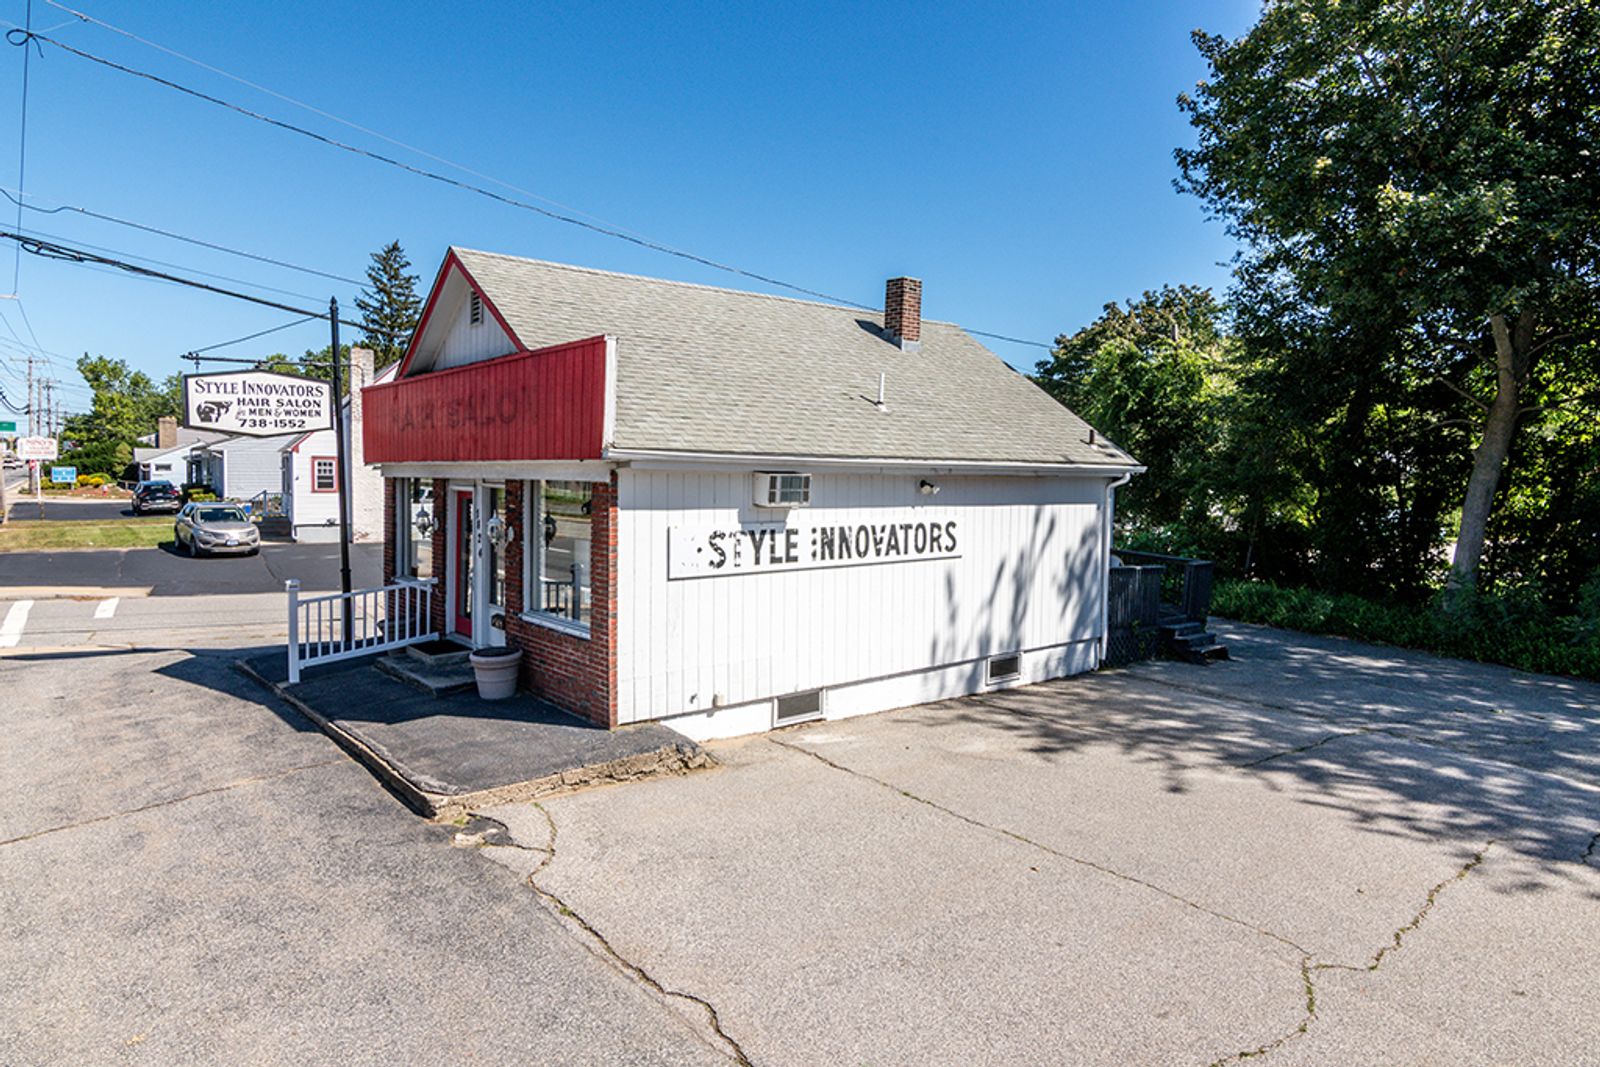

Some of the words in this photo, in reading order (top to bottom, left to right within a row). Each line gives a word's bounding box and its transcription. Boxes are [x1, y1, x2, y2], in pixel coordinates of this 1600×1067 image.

[195, 378, 239, 394] STYLE
[242, 380, 324, 398] INNOVATORS
[237, 397, 270, 407] HAIR
[276, 398, 321, 408] SALON
[248, 408, 272, 417] MEN
[283, 408, 321, 418] WOMEN
